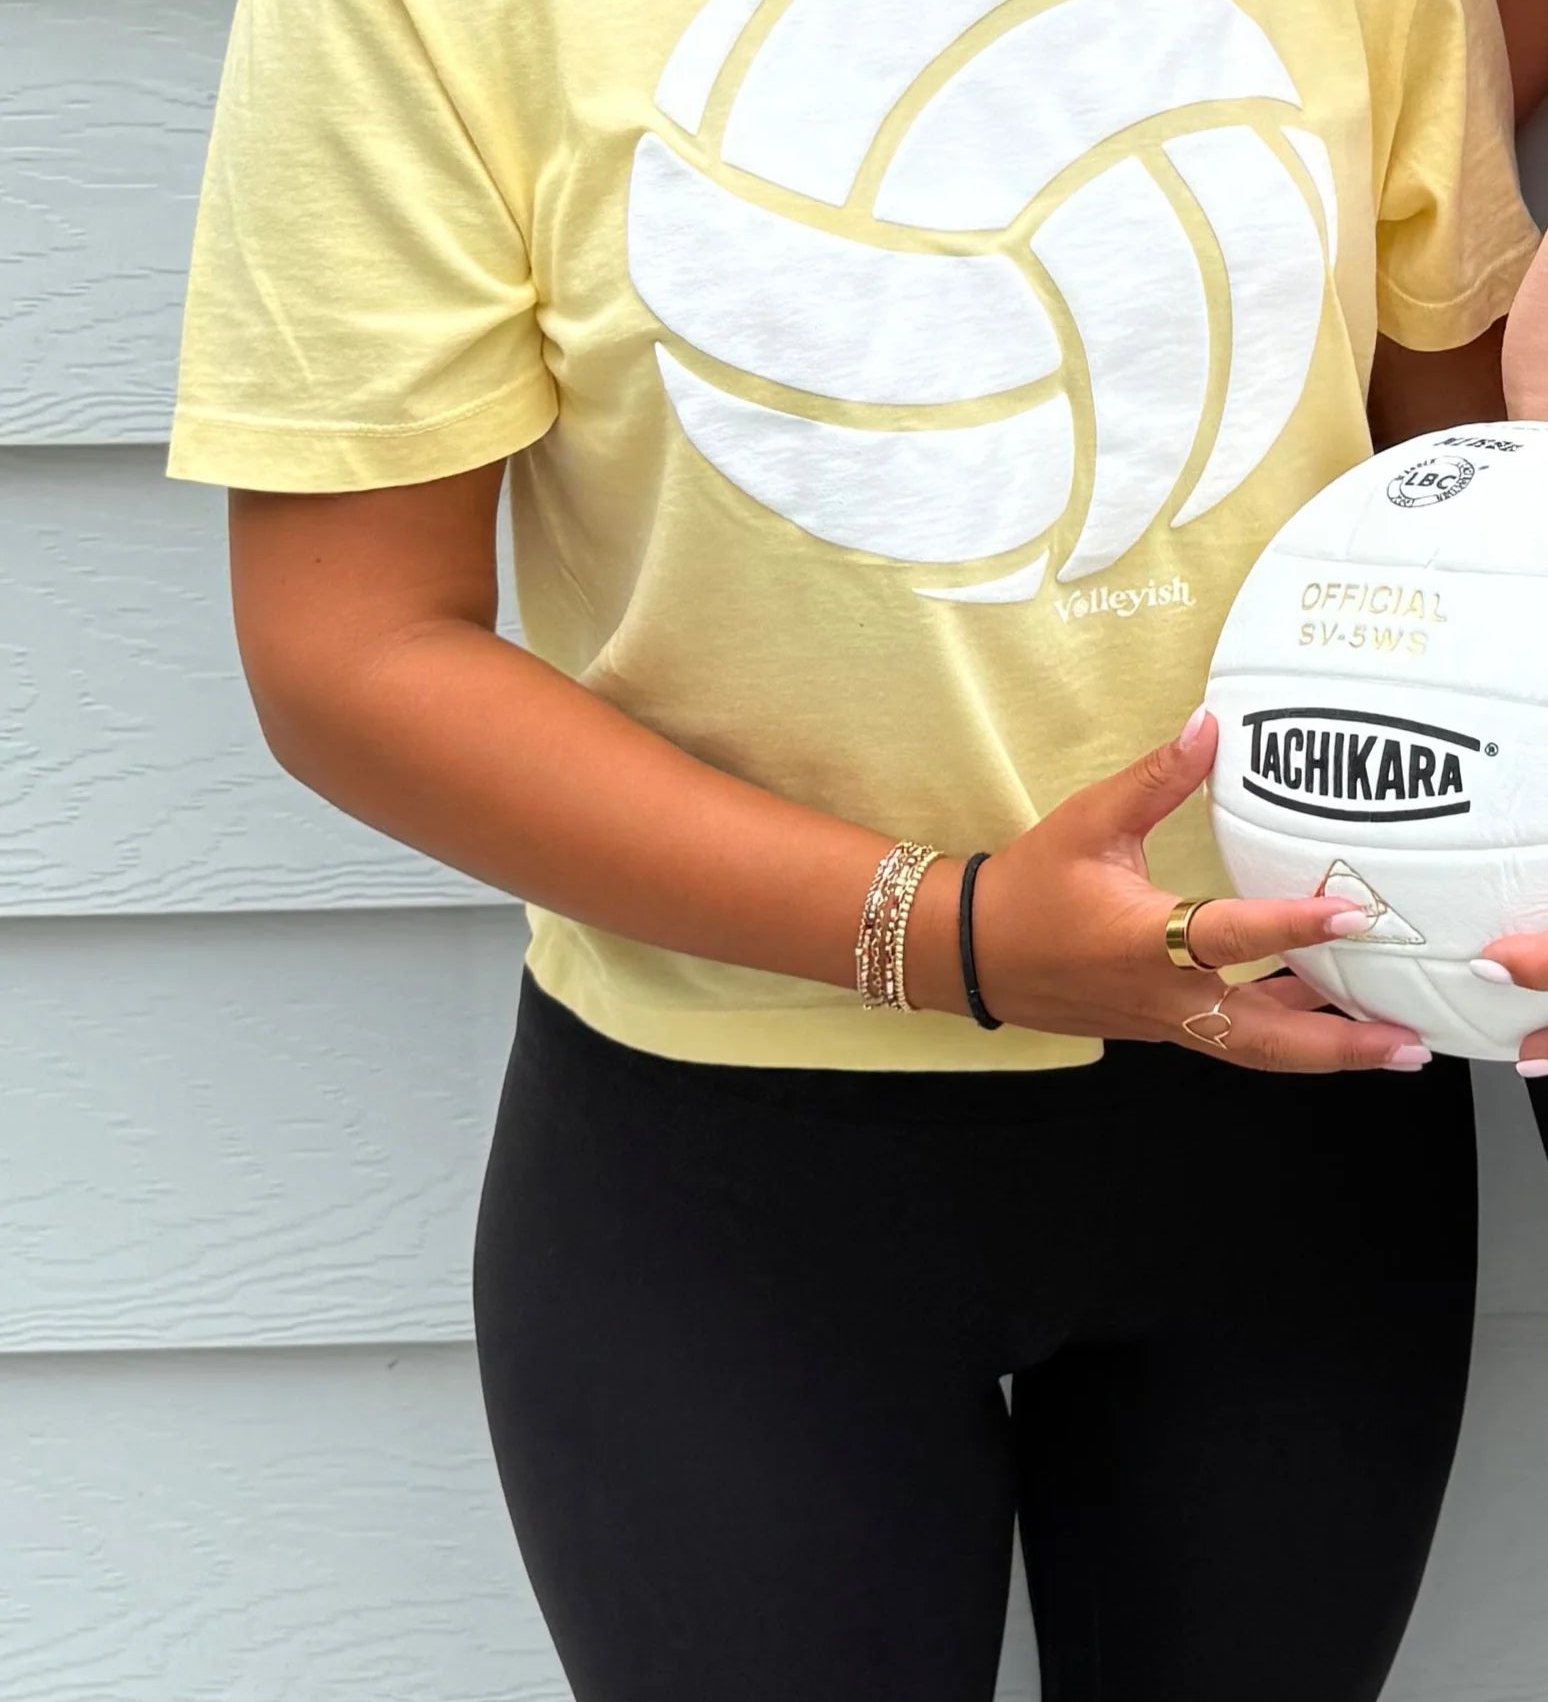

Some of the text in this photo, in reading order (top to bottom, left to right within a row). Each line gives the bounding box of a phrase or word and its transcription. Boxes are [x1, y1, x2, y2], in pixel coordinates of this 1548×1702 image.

[1404, 471, 1457, 490] LBC
[1053, 576, 1197, 624] Volleyish
[1301, 582, 1448, 623] OFFICIAL
[1298, 621, 1429, 655] SV-5WS
[1242, 707, 1481, 801] TACHIKARA
